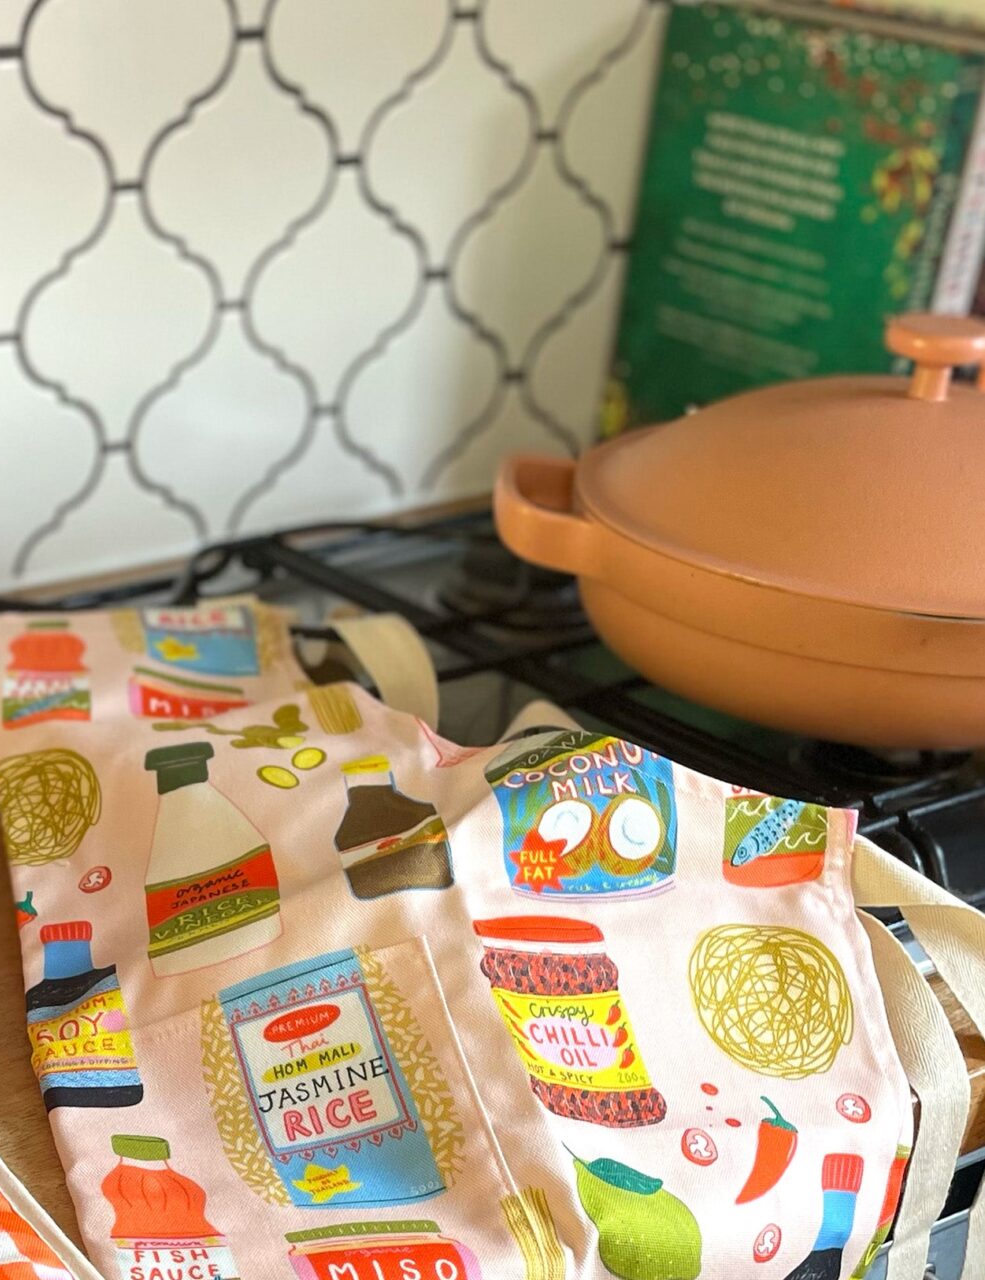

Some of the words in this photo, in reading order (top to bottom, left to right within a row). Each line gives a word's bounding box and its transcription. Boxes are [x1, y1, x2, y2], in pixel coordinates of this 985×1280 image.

[551, 772, 637, 801] MILK
[520, 850, 556, 864] FULL
[523, 866, 554, 882] FAT
[170, 879, 251, 909] JAPANESE
[178, 896, 248, 926] RICE
[271, 1011, 334, 1035] PREMIUM
[529, 1023, 609, 1048] CHILLI
[280, 1033, 330, 1059] Thai
[560, 1048, 598, 1067] OIL
[273, 1058, 308, 1080] HOM
[318, 1044, 356, 1065] MALI
[527, 1061, 544, 1074] HOT
[559, 1071, 594, 1085] SPICY
[258, 1056, 390, 1114] JASMINE
[282, 1089, 378, 1142] RICE
[134, 1249, 209, 1263] FISH
